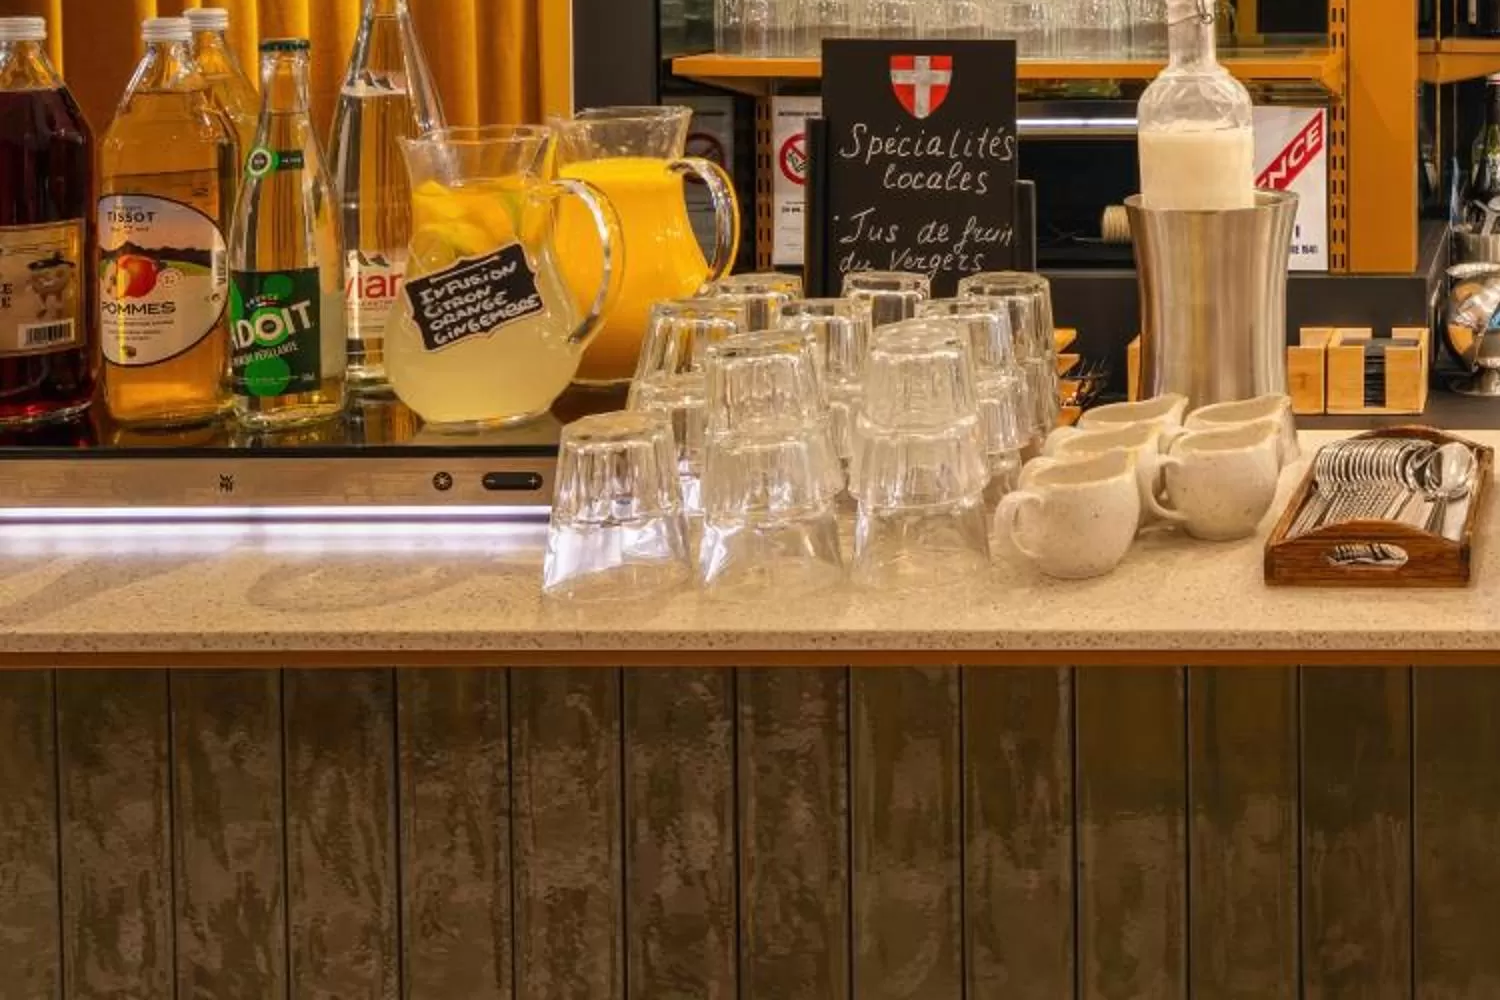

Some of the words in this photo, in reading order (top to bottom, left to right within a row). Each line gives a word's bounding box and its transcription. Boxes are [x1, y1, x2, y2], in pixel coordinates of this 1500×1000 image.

[839, 123, 1015, 164] Spécialités
[107, 211, 156, 223] TISSOT
[840, 207, 899, 244] Jus
[917, 219, 950, 245] de
[839, 250, 874, 273] du
[101, 301, 177, 315] POMMES
[430, 290, 508, 331] ORANGE
